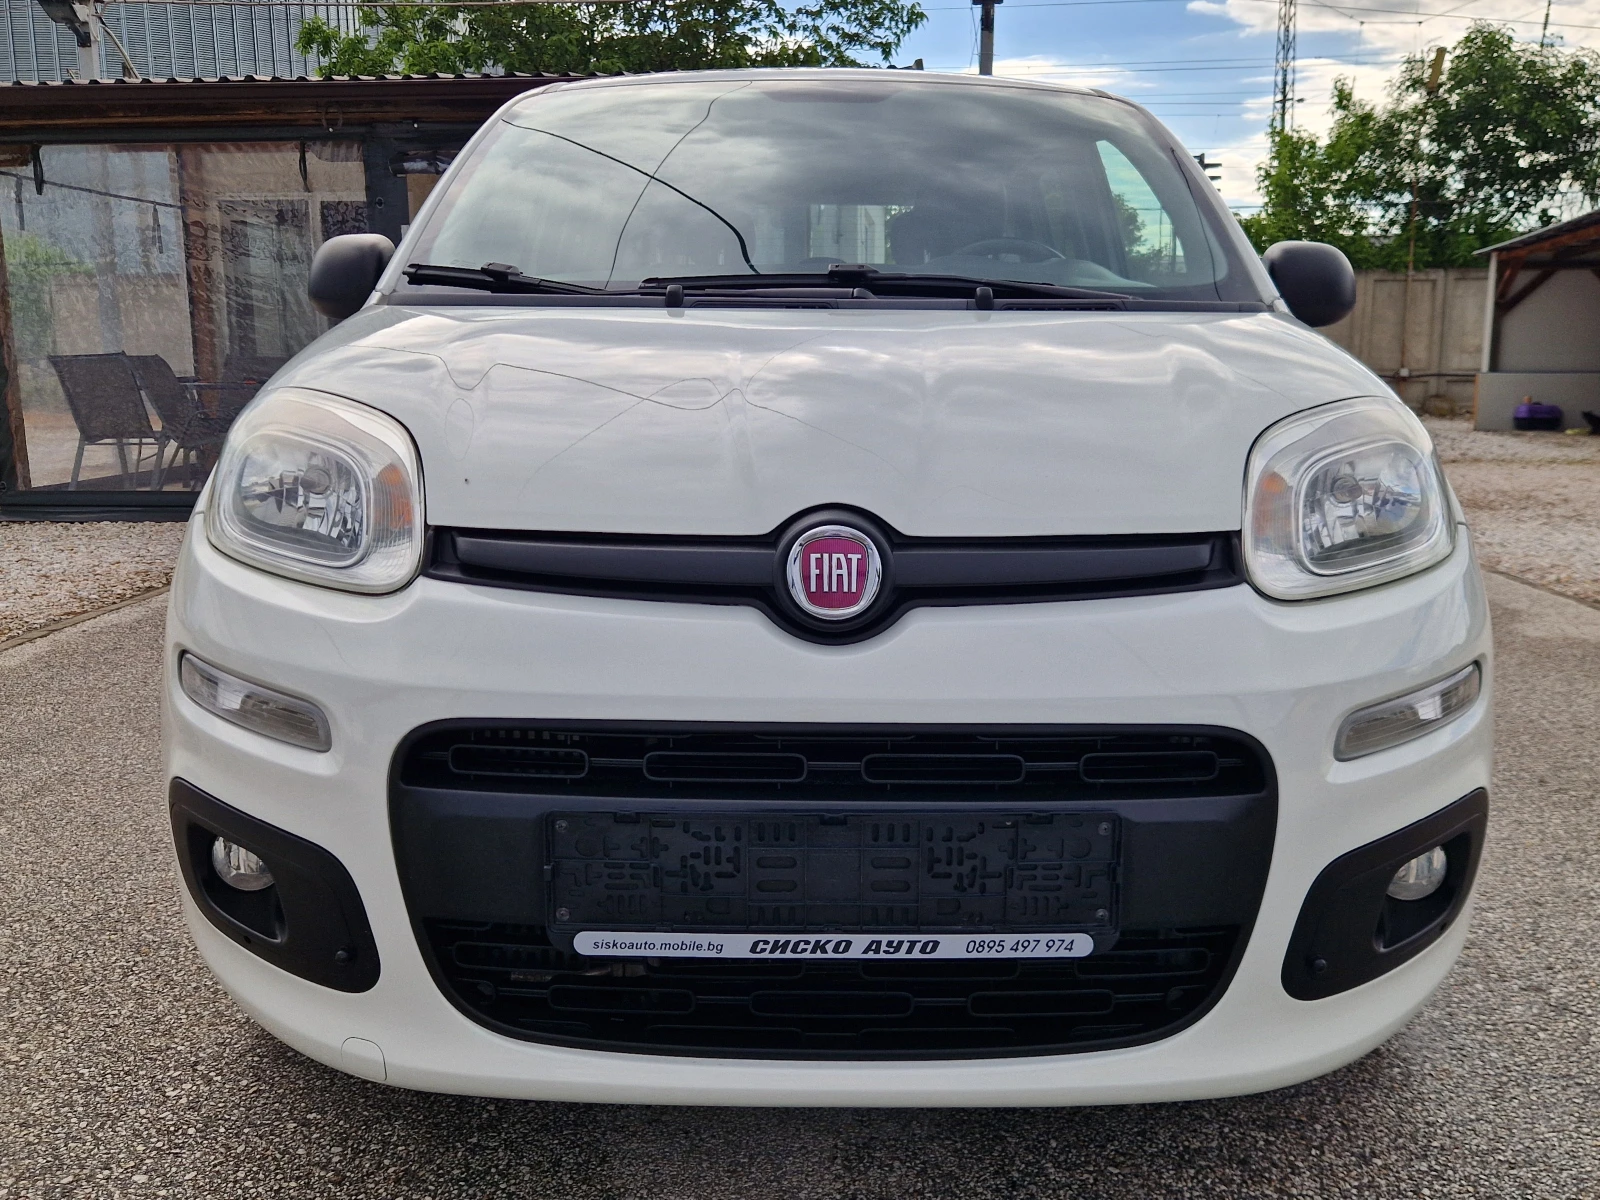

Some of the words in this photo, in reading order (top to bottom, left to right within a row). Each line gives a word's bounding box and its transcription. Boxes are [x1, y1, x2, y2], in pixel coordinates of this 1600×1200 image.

[809, 553, 862, 593] FIAT
[592, 938, 724, 954] siskoauto.mobile.bg
[749, 939, 853, 955] СИСКО
[861, 939, 941, 955] АУТО
[965, 939, 1005, 954] 0895
[1009, 939, 1040, 953] 497
[1045, 939, 1075, 953] 974
